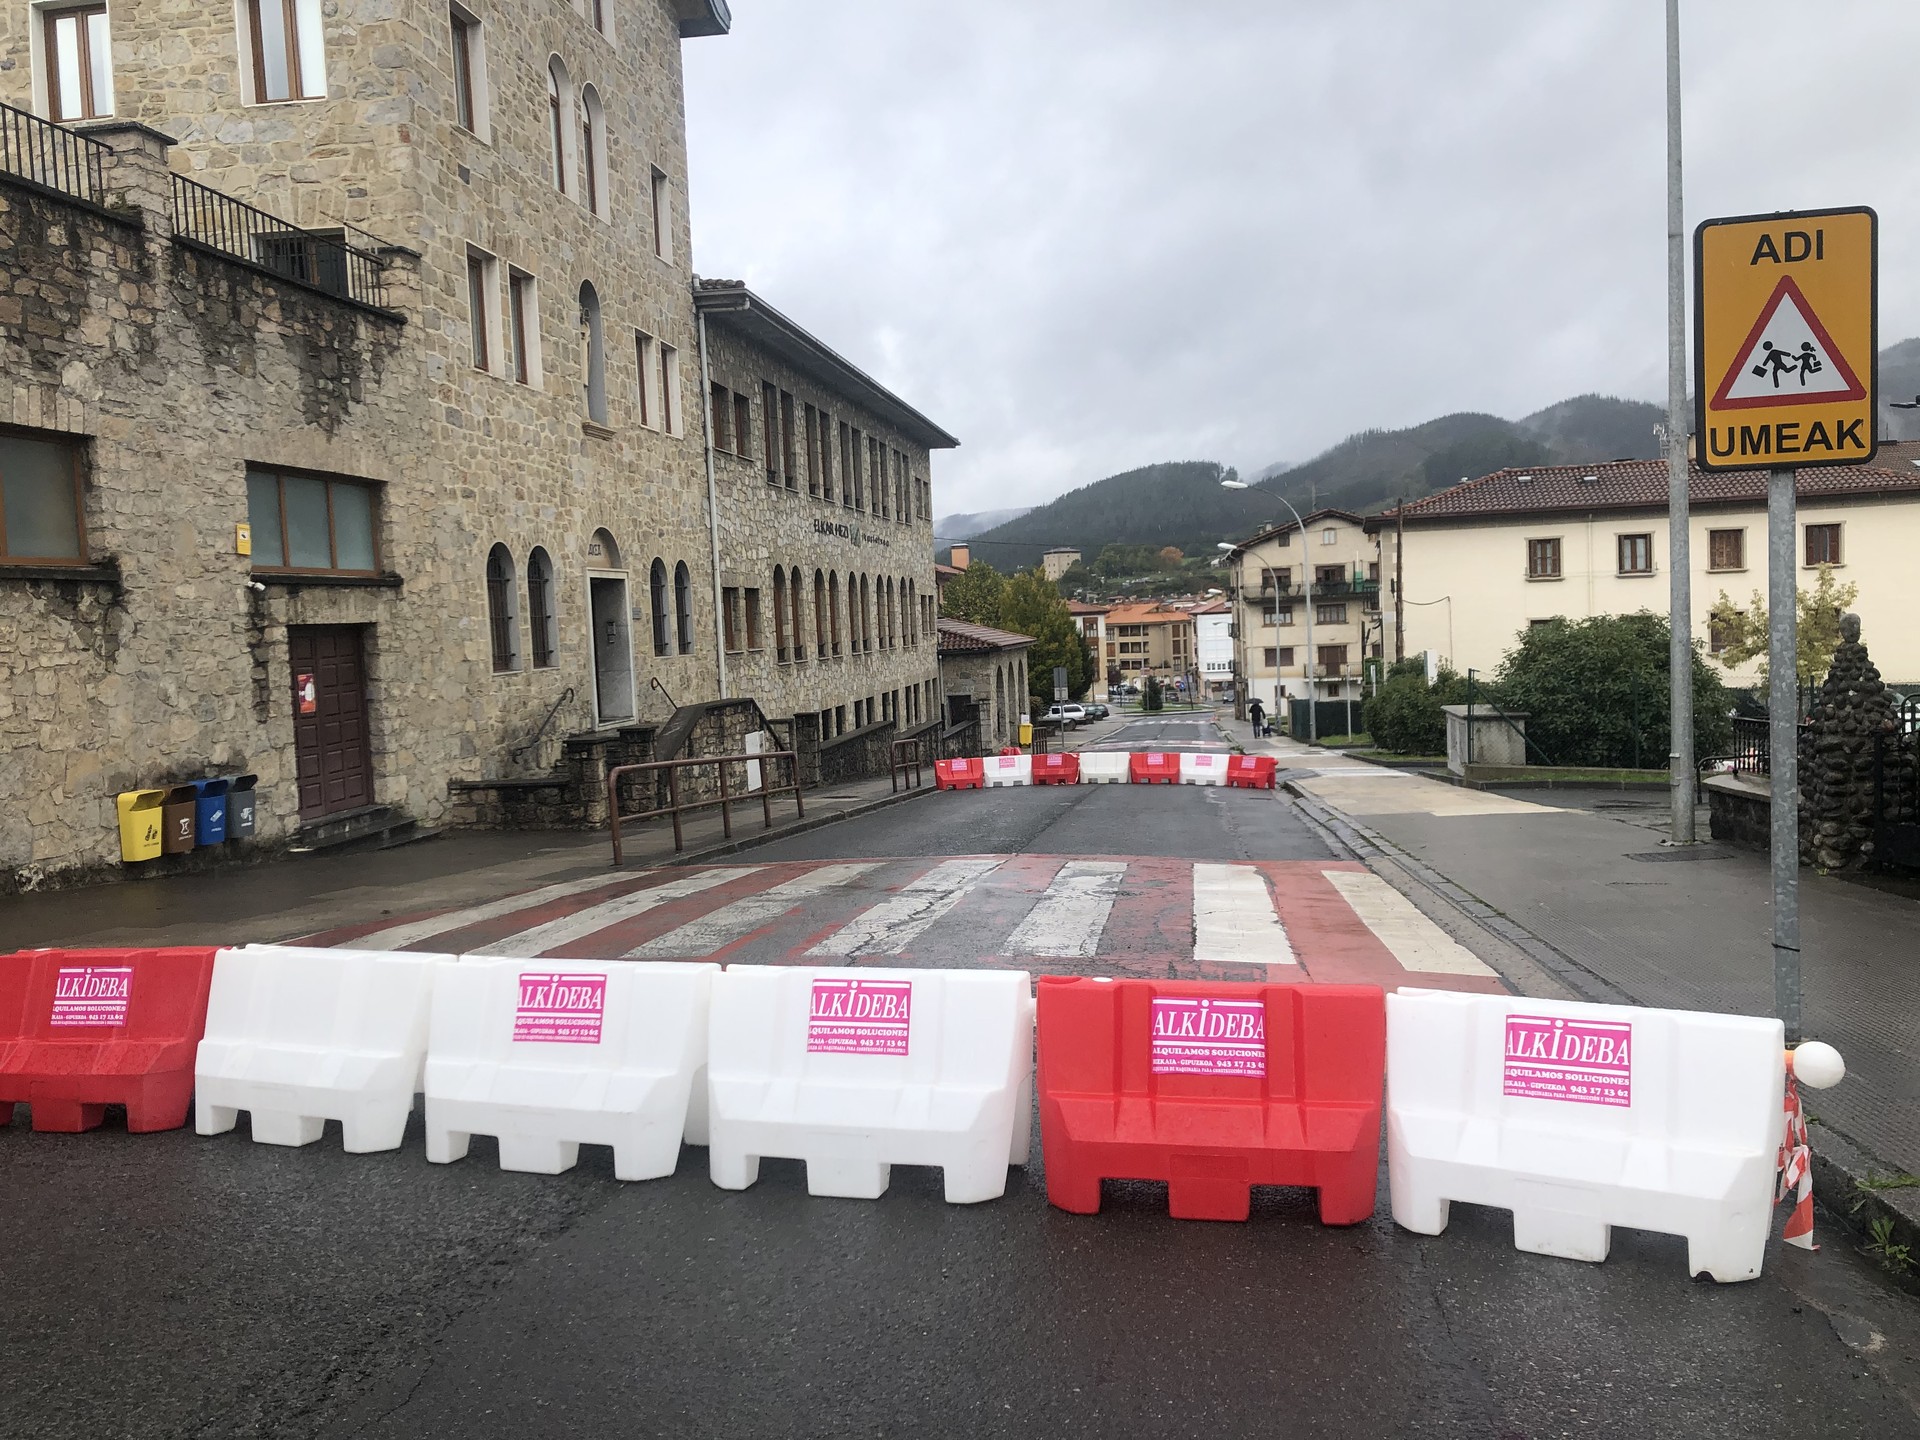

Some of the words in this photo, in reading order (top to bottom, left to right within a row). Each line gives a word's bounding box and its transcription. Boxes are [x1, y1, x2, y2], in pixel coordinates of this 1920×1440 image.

[1750, 229, 1824, 266] ADI
[1710, 418, 1866, 457] UMEAK
[856, 1028, 907, 1037] SOLUCIONES
[860, 1039, 874, 1047] 943
[1153, 1047, 1210, 1056] ALQUILAMOS
[1565, 1074, 1629, 1086] SOLUCIONES
[1531, 1082, 1566, 1091] GIPUZKOA
[1570, 1085, 1588, 1094] 943
[1590, 1087, 1601, 1095] 17
[1604, 1088, 1615, 1096] 13
[1618, 1089, 1628, 1097] 62
